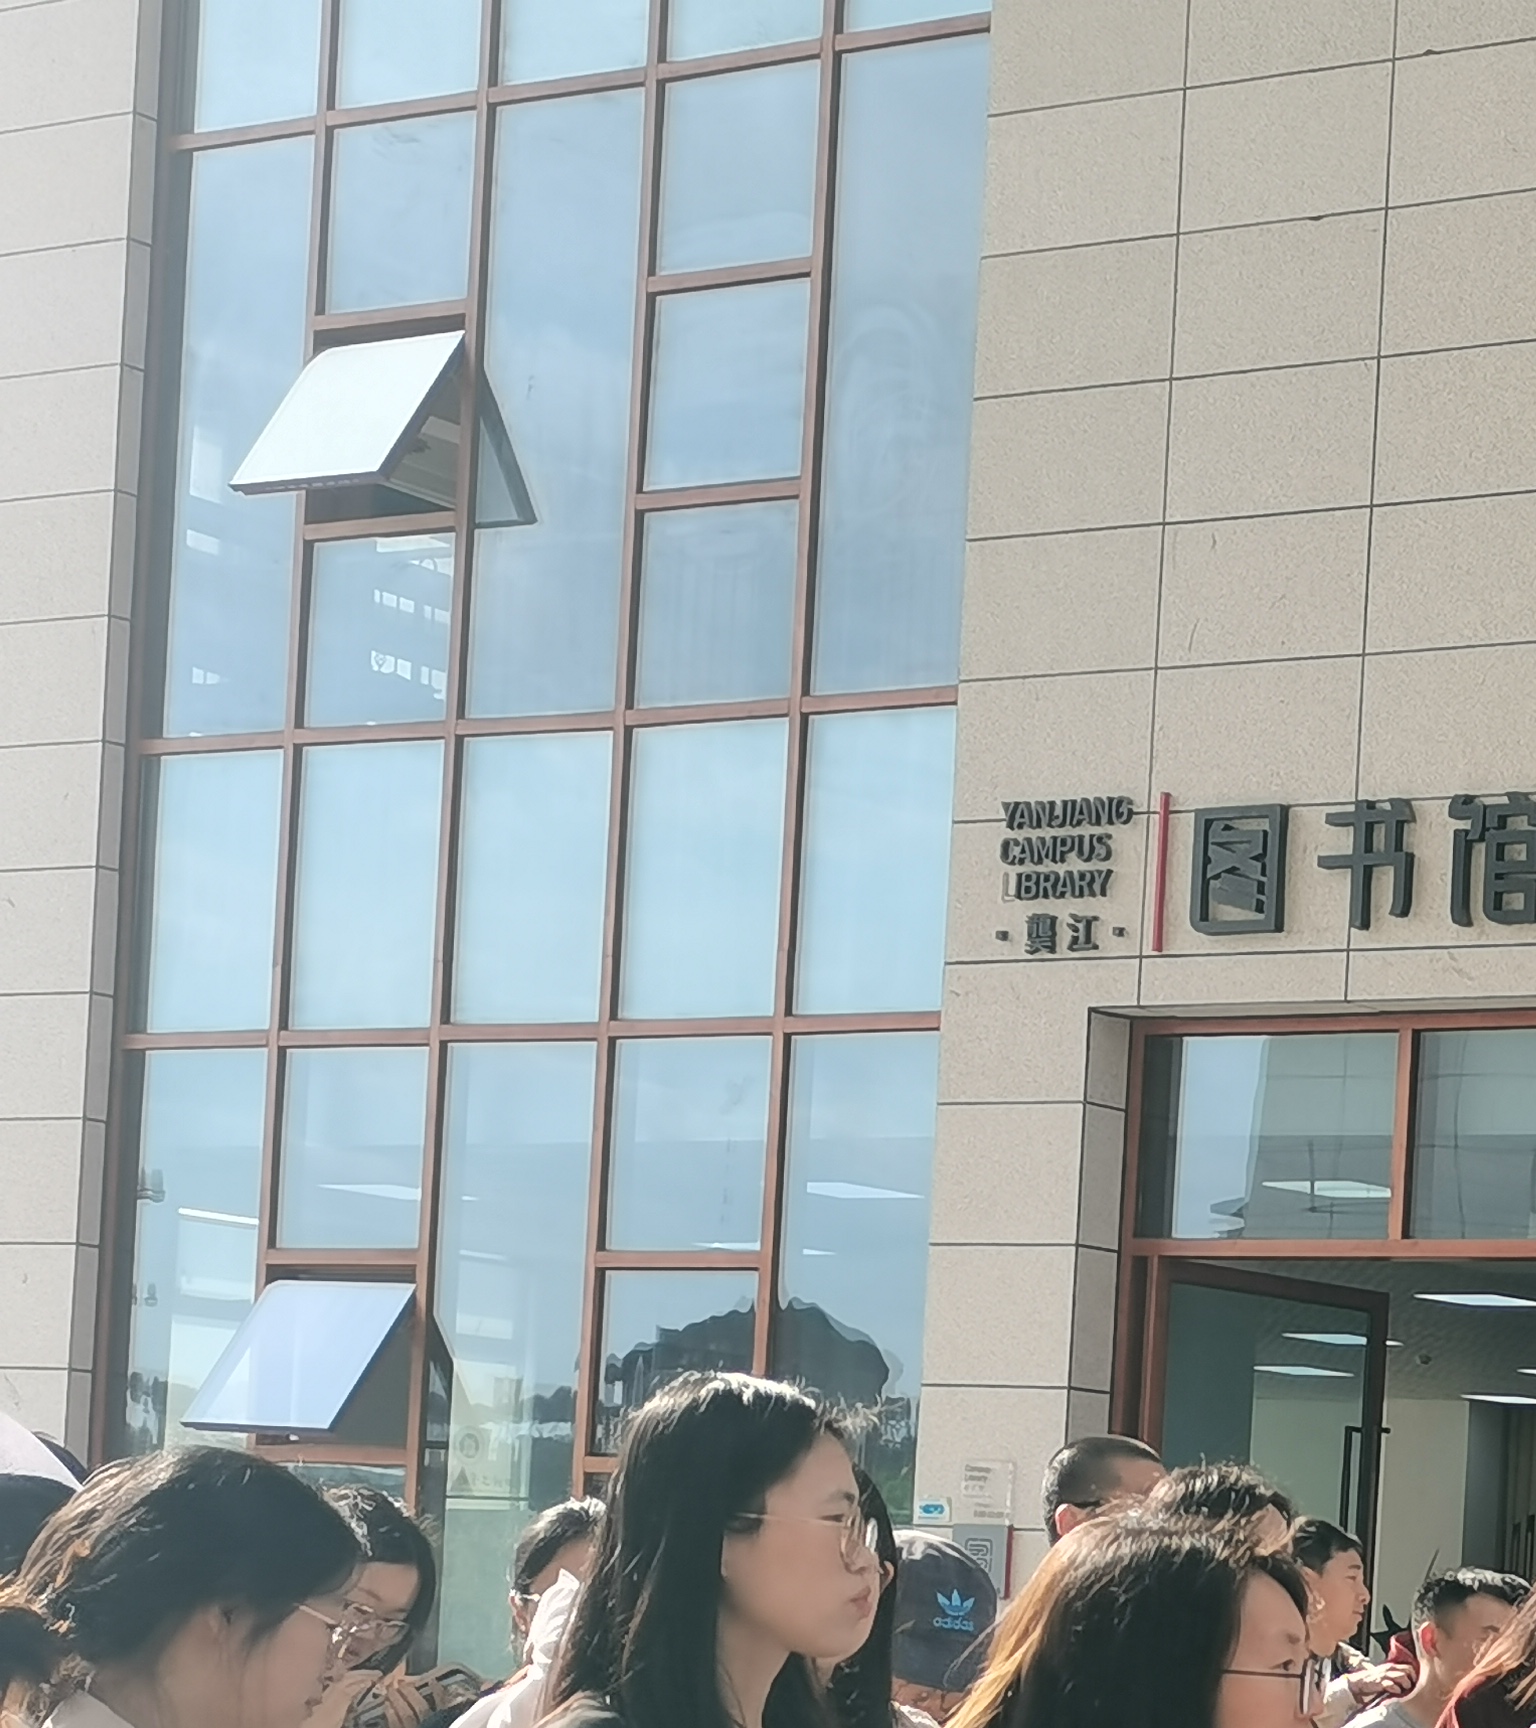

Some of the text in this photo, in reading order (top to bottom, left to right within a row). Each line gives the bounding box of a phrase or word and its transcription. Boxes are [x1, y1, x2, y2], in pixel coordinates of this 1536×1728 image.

[1001, 796, 1134, 831] YANJIANG
[1000, 833, 1113, 866] CAMPUS
[1001, 869, 1114, 903] LIBRARY
